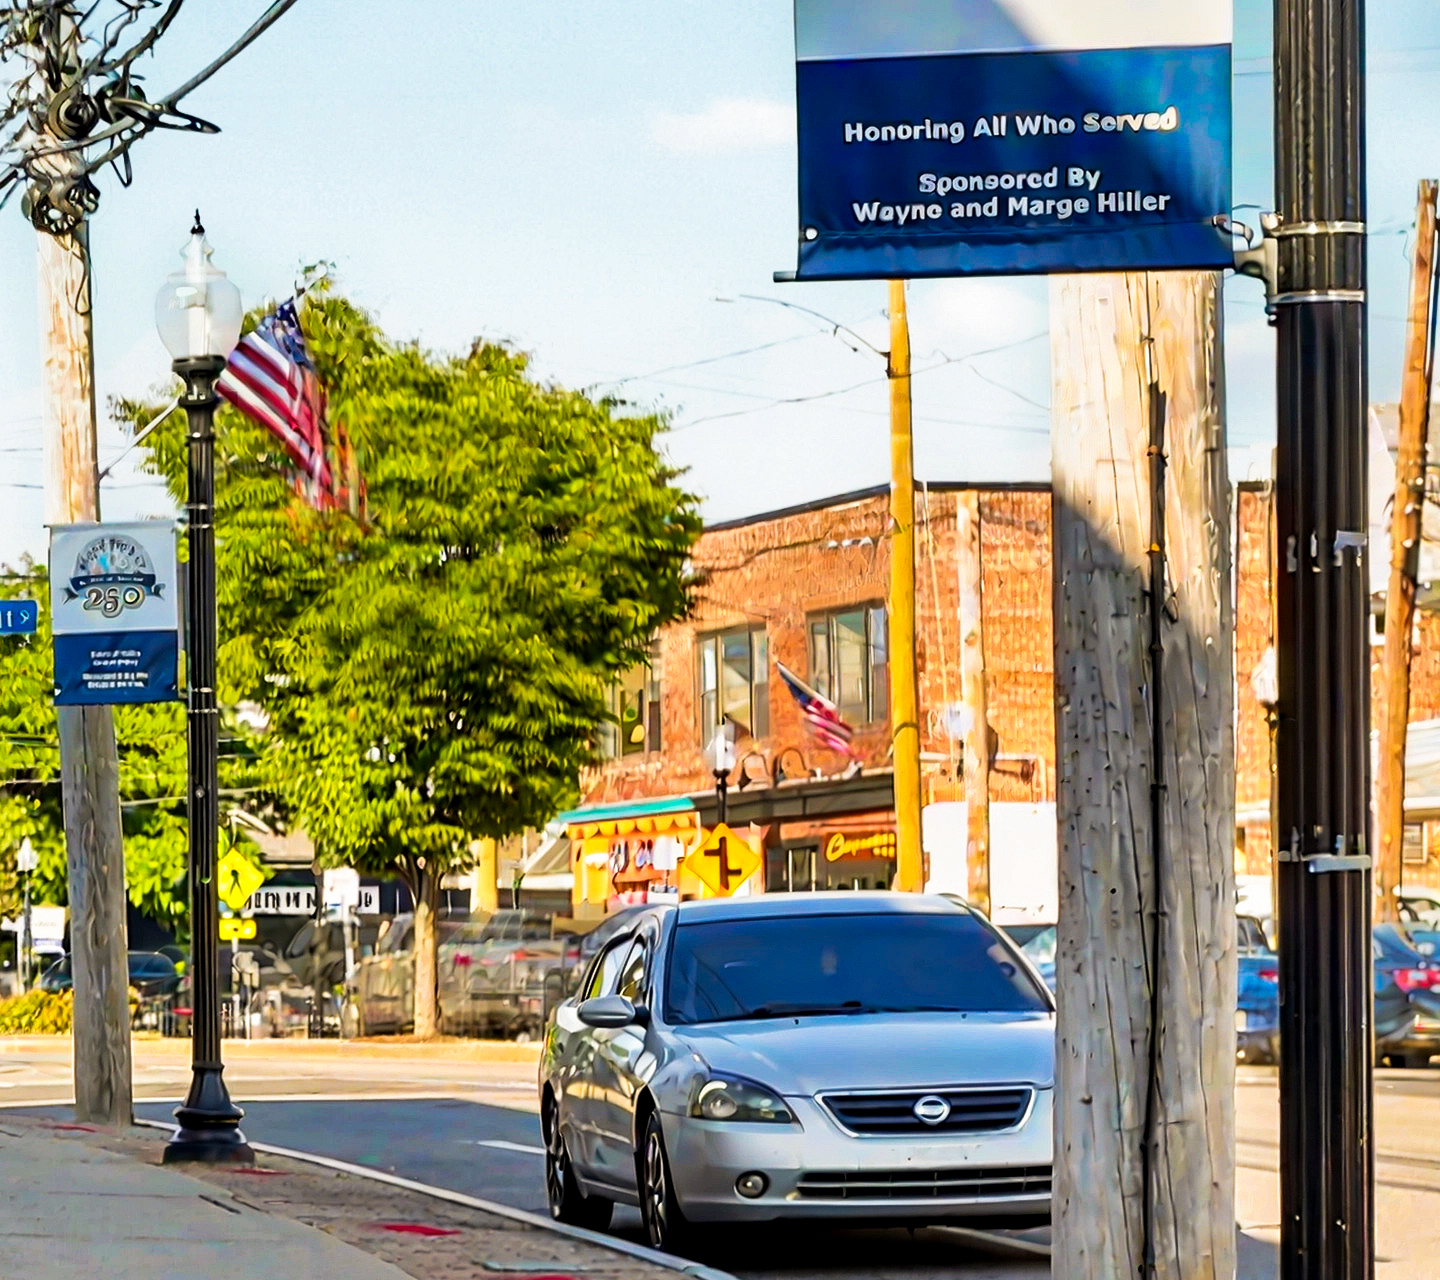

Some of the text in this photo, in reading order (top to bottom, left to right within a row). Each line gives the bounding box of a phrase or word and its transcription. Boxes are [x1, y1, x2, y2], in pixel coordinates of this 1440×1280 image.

[844, 106, 1178, 144] Honoring All Who Served
[919, 167, 1101, 197] Sponsored By
[852, 191, 1172, 226] Wayne and Marge Hiller
